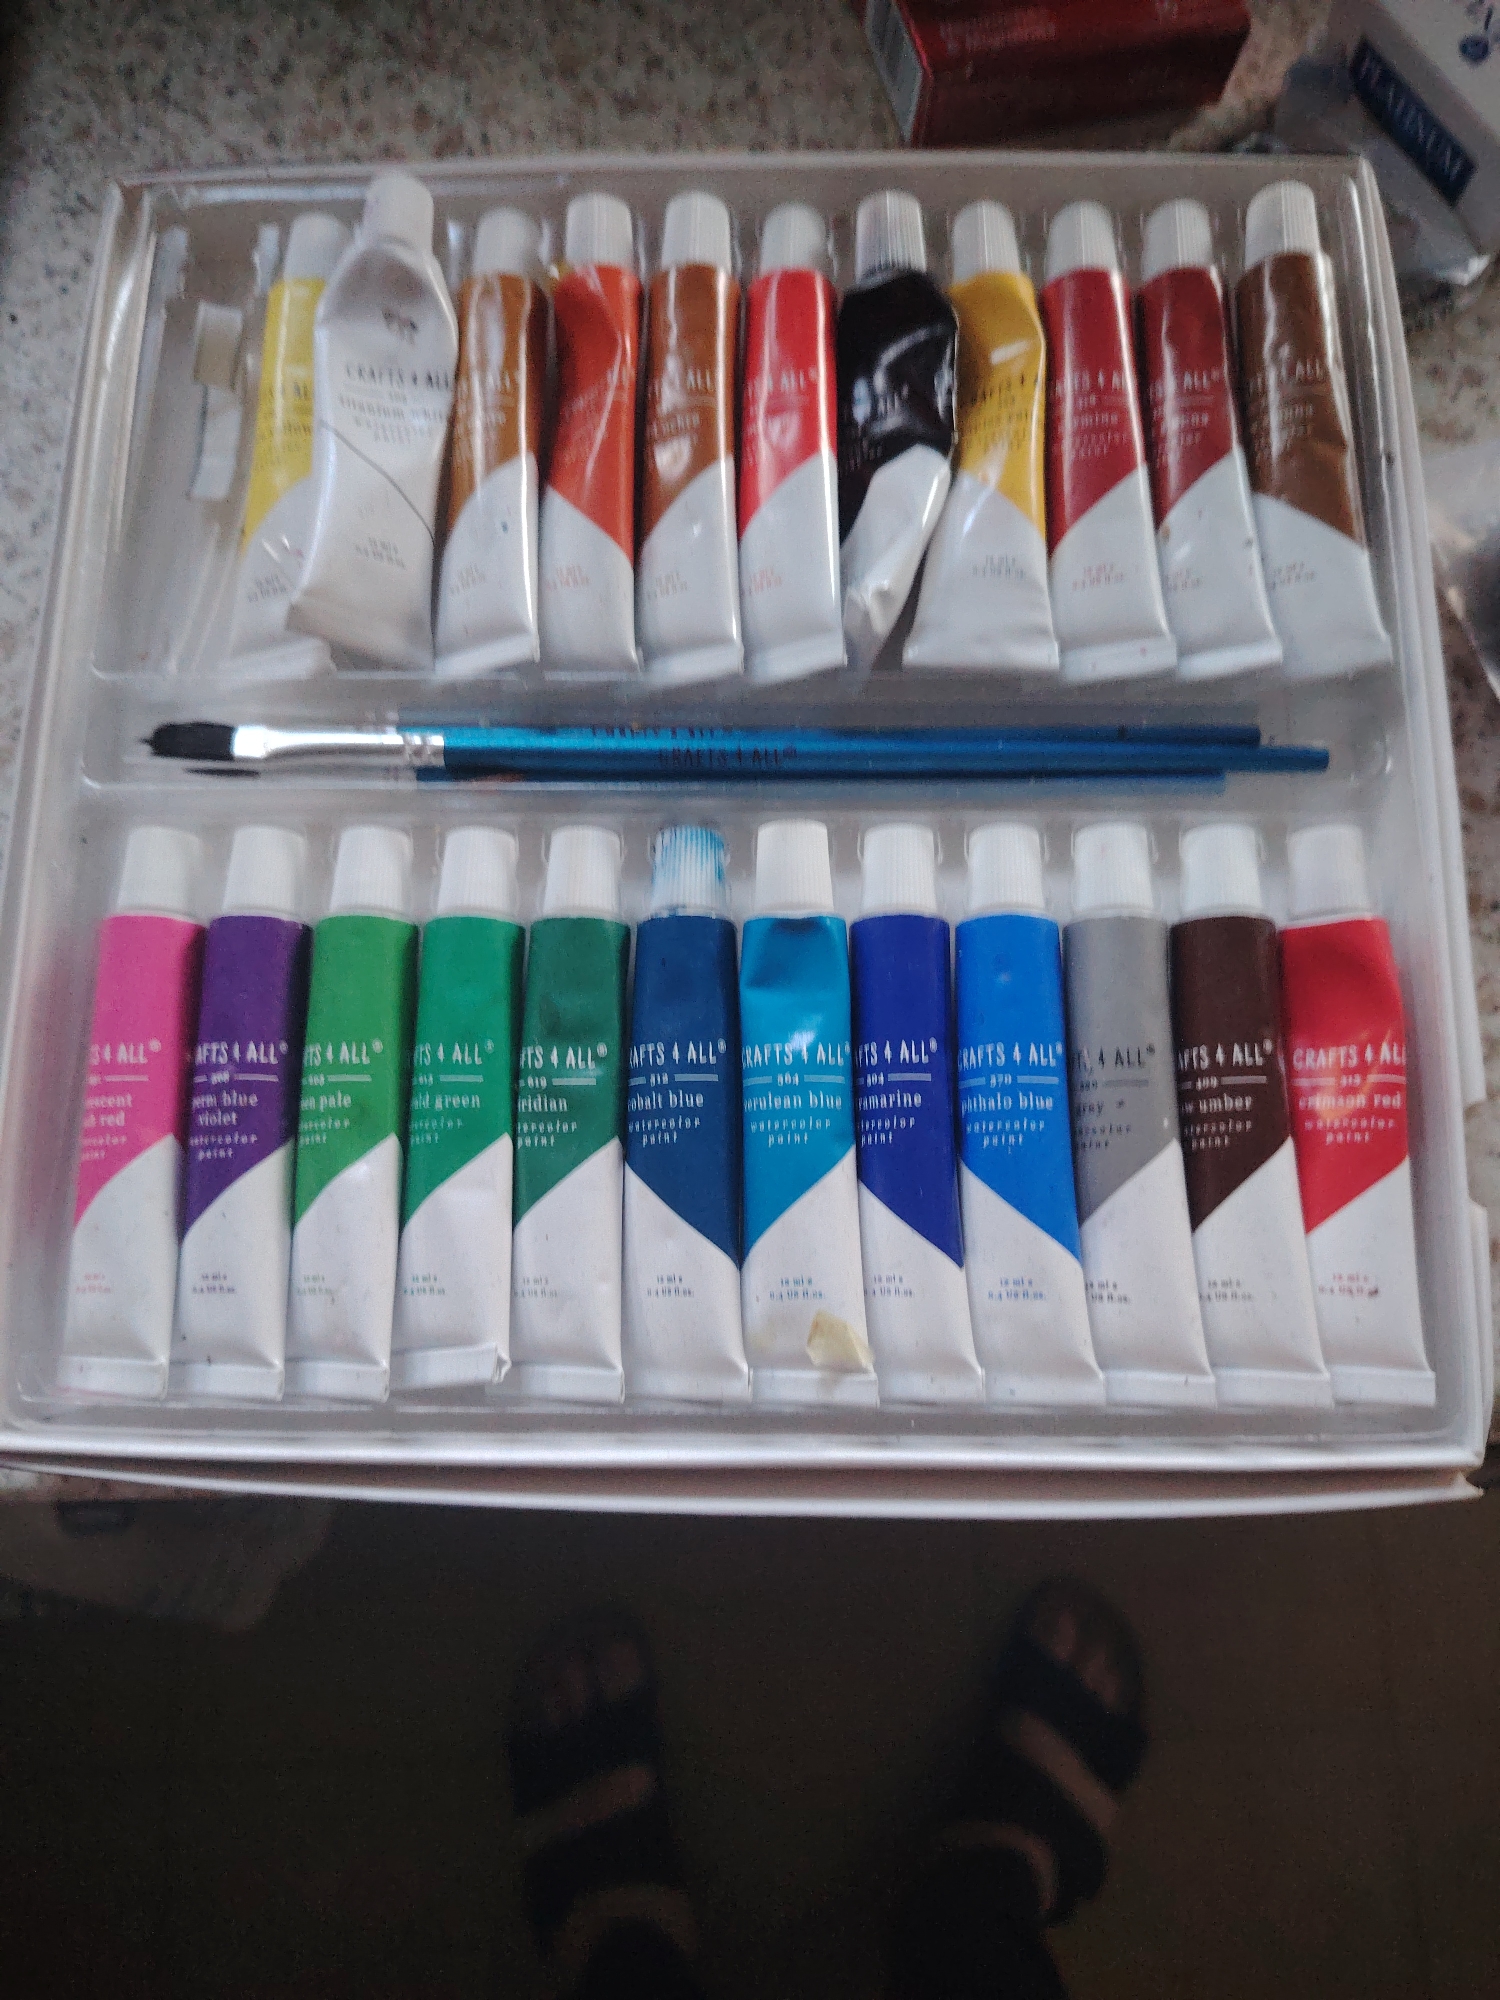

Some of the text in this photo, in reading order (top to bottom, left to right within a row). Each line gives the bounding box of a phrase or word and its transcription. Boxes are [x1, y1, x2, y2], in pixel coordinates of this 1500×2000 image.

[550, 1045, 559, 1069] 4
[673, 1041, 679, 1065] 4
[884, 1040, 892, 1064] 4
[1013, 1042, 1021, 1065] 4
[1216, 1043, 1225, 1067] 4
[1292, 1045, 1358, 1070] CRAFTS
[222, 1089, 258, 1106] blue
[320, 1090, 351, 1112] pale
[435, 1094, 480, 1111] green
[669, 1089, 704, 1108] blue
[809, 1090, 842, 1110] blue
[1019, 1091, 1053, 1110] blue
[1199, 1092, 1252, 1114] umber
[1374, 1091, 1401, 1107] red
[198, 1109, 237, 1126] violet
